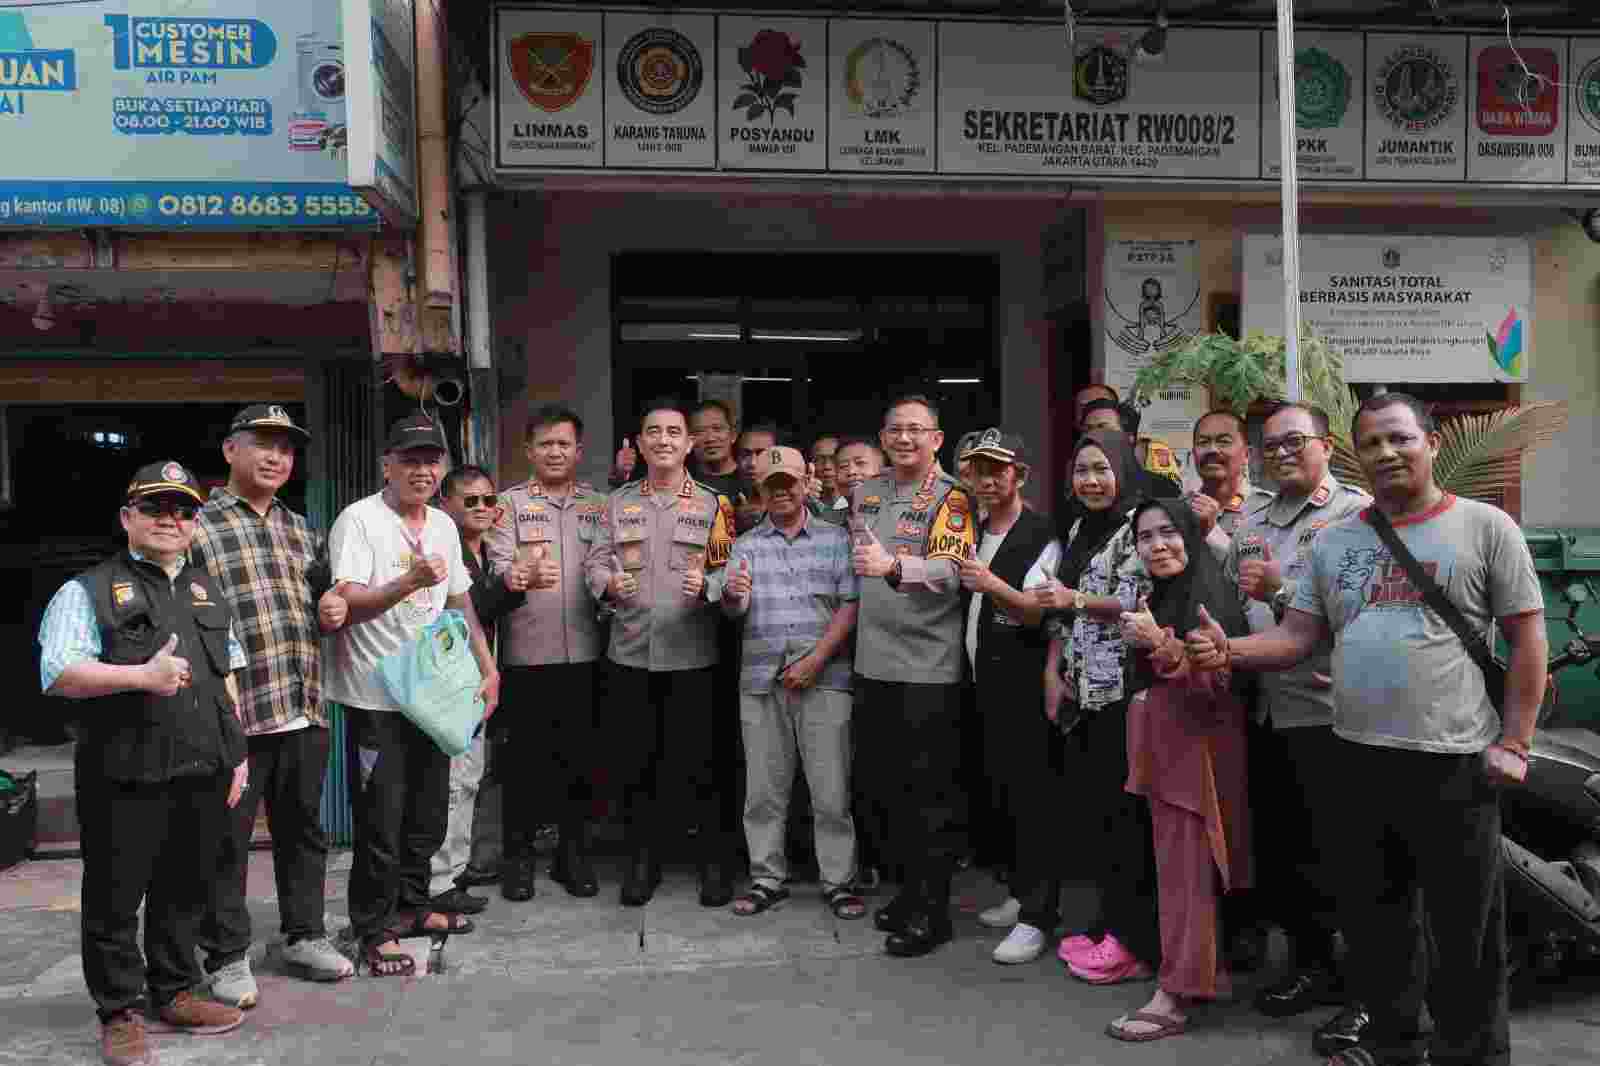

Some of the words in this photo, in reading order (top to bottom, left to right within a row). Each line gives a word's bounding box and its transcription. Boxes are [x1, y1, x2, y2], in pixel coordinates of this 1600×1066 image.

[135, 23, 252, 41] CUSTOMER
[136, 41, 254, 65] MESIN
[146, 71, 176, 84] AIR
[180, 71, 217, 85] PAM
[114, 99, 159, 113] BUKA
[164, 99, 222, 113] SETIAP
[225, 99, 266, 113] HARI
[183, 115, 231, 129] 21.00
[237, 116, 266, 129] WIB
[964, 110, 1130, 142] SEKRETARIAT
[1136, 114, 1235, 144] RW008/2
[513, 123, 589, 139] LINMAS
[614, 125, 658, 140] KARANG
[663, 126, 706, 142] TARUNA
[730, 127, 814, 142] POSYANDU
[863, 130, 901, 144] LMK
[1004, 143, 1078, 155] PADEMANGAN
[1377, 140, 1455, 155] JUMANTIK
[1042, 156, 1091, 167] JAKARTA
[1092, 156, 1128, 168] UTARA
[14, 196, 64, 214] kantor
[158, 195, 226, 216] 0812
[230, 195, 298, 216] 8683
[304, 195, 371, 217] 5555
[1330, 274, 1395, 288] SANITASI
[1399, 275, 1442, 288] TOTAL
[1300, 290, 1368, 304] BERBASIS
[1372, 290, 1472, 304] MASYARAKAT
[771, 450, 784, 465] B
